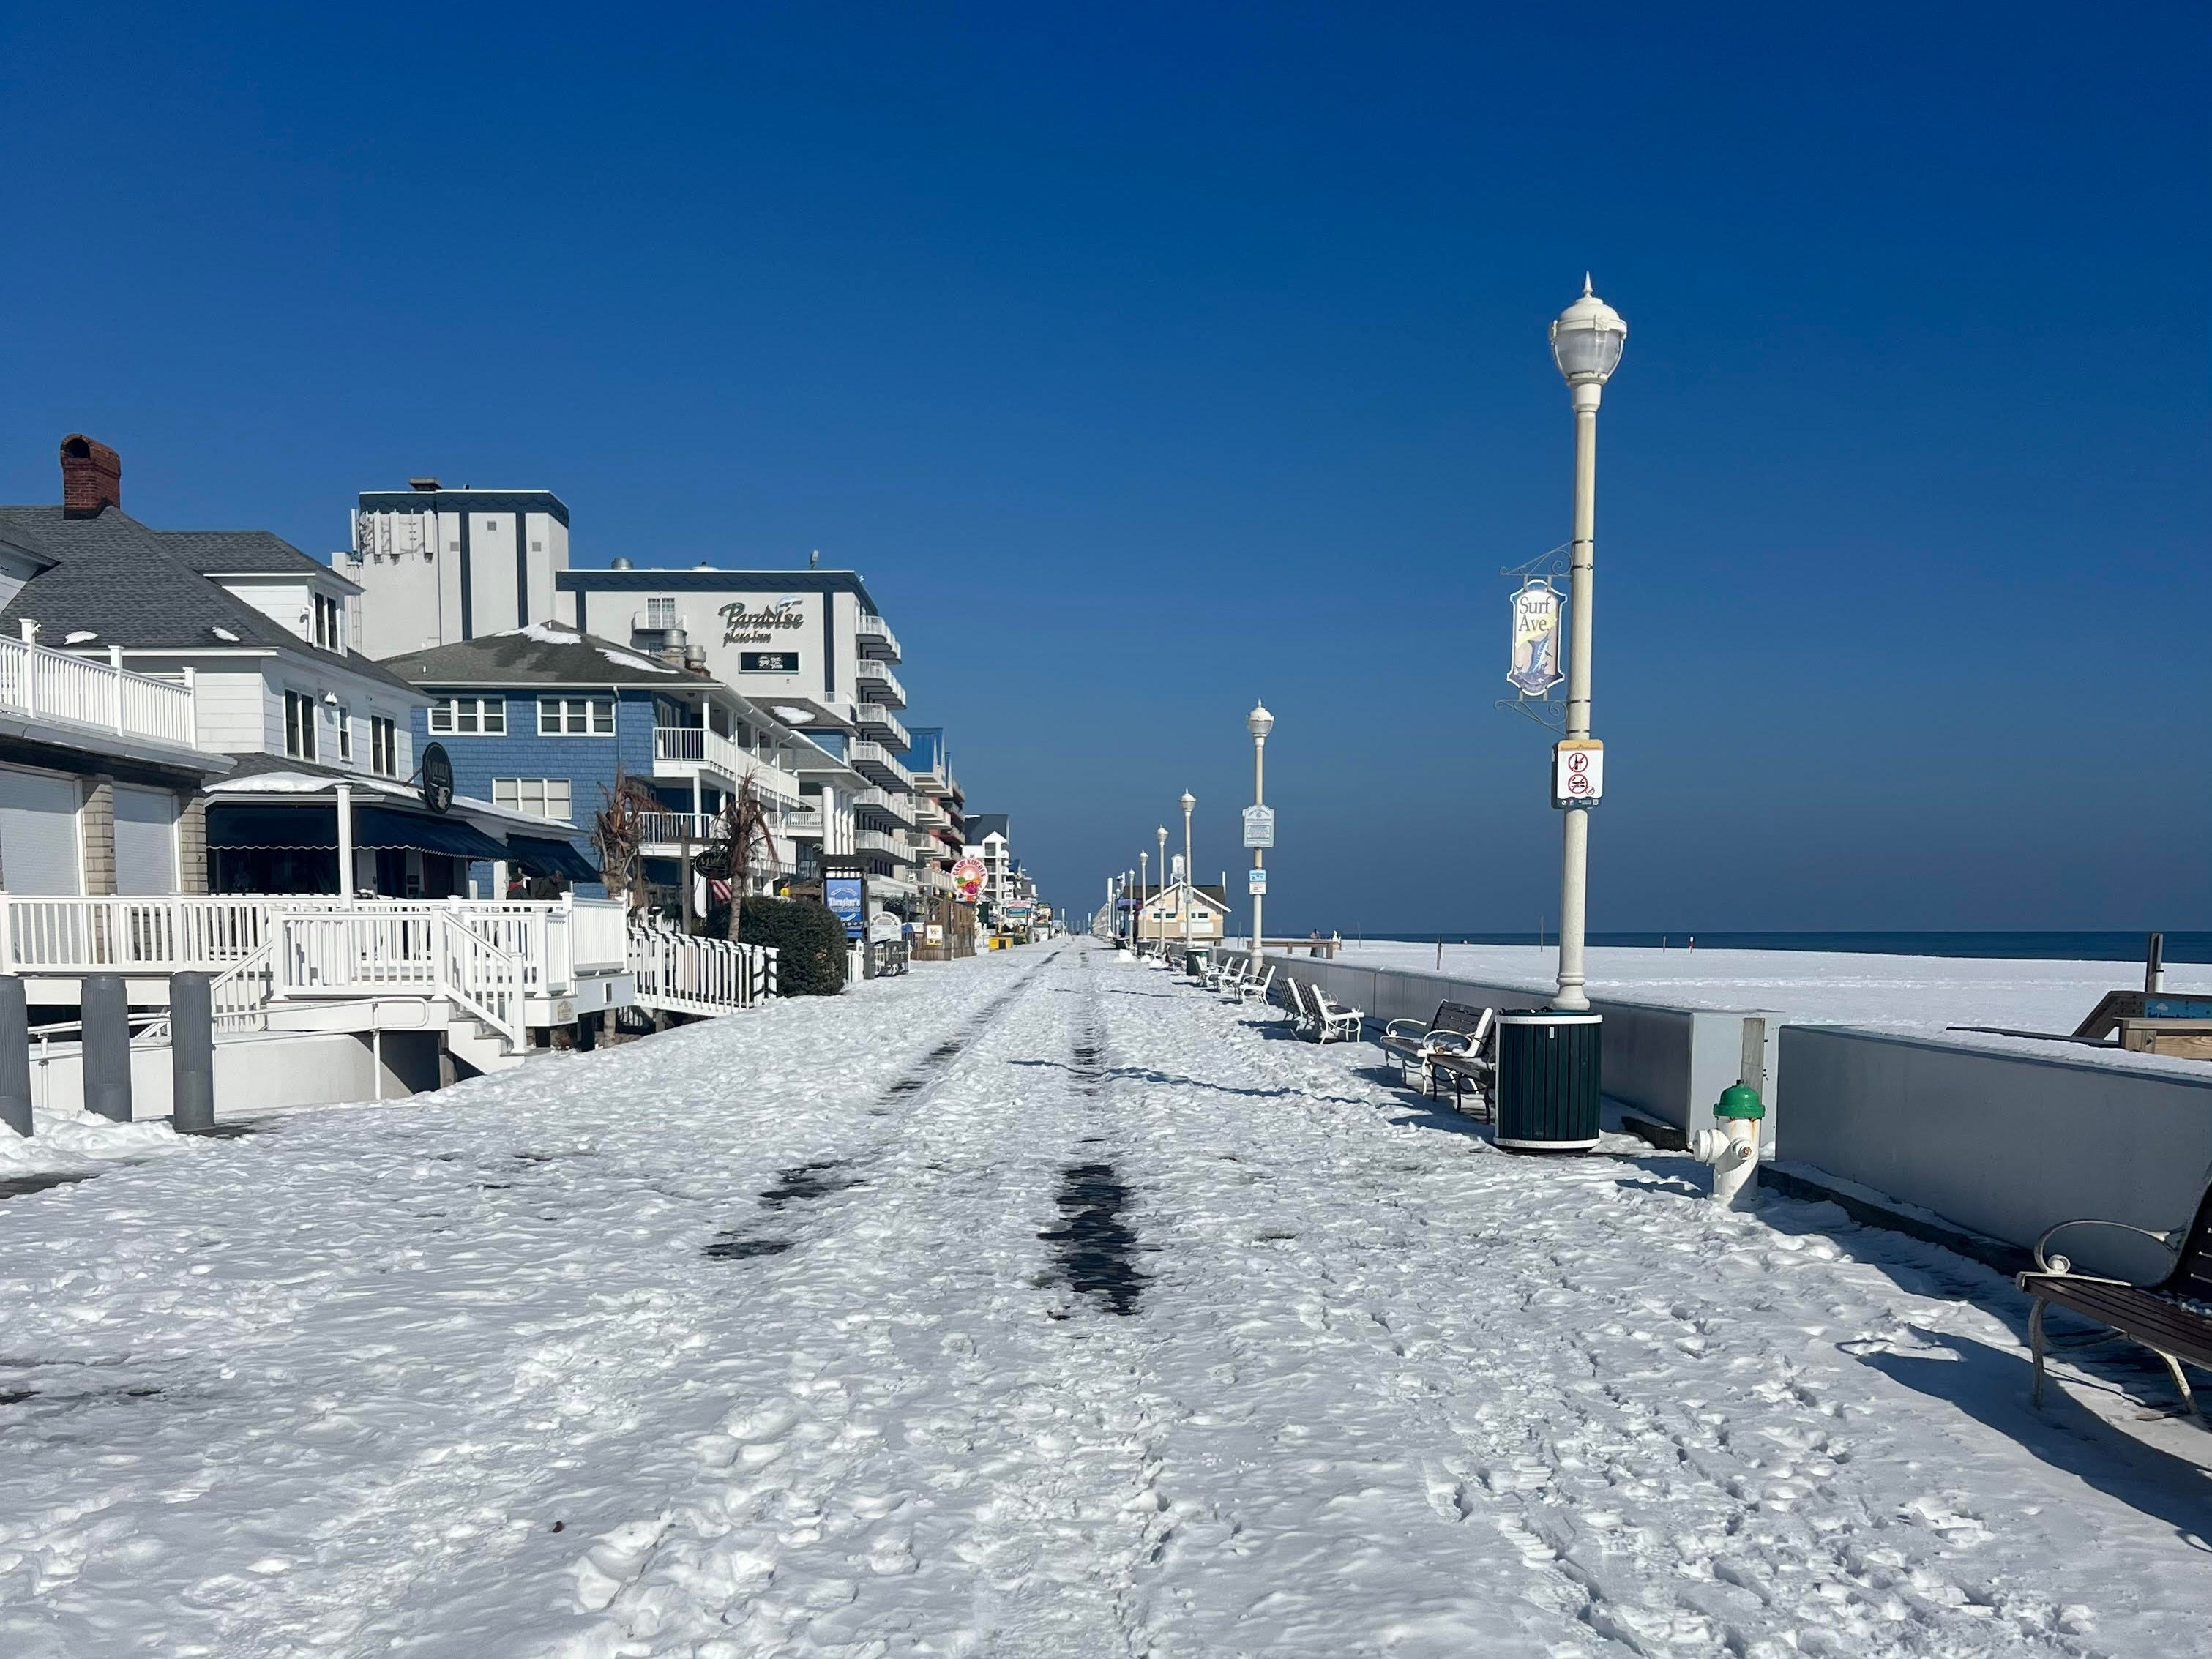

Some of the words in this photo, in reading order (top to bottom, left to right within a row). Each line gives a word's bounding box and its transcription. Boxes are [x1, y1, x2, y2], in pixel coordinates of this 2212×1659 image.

[1520, 596, 1551, 614] Surf
[718, 602, 804, 629] Paradise
[1518, 614, 1550, 632] Ave.
